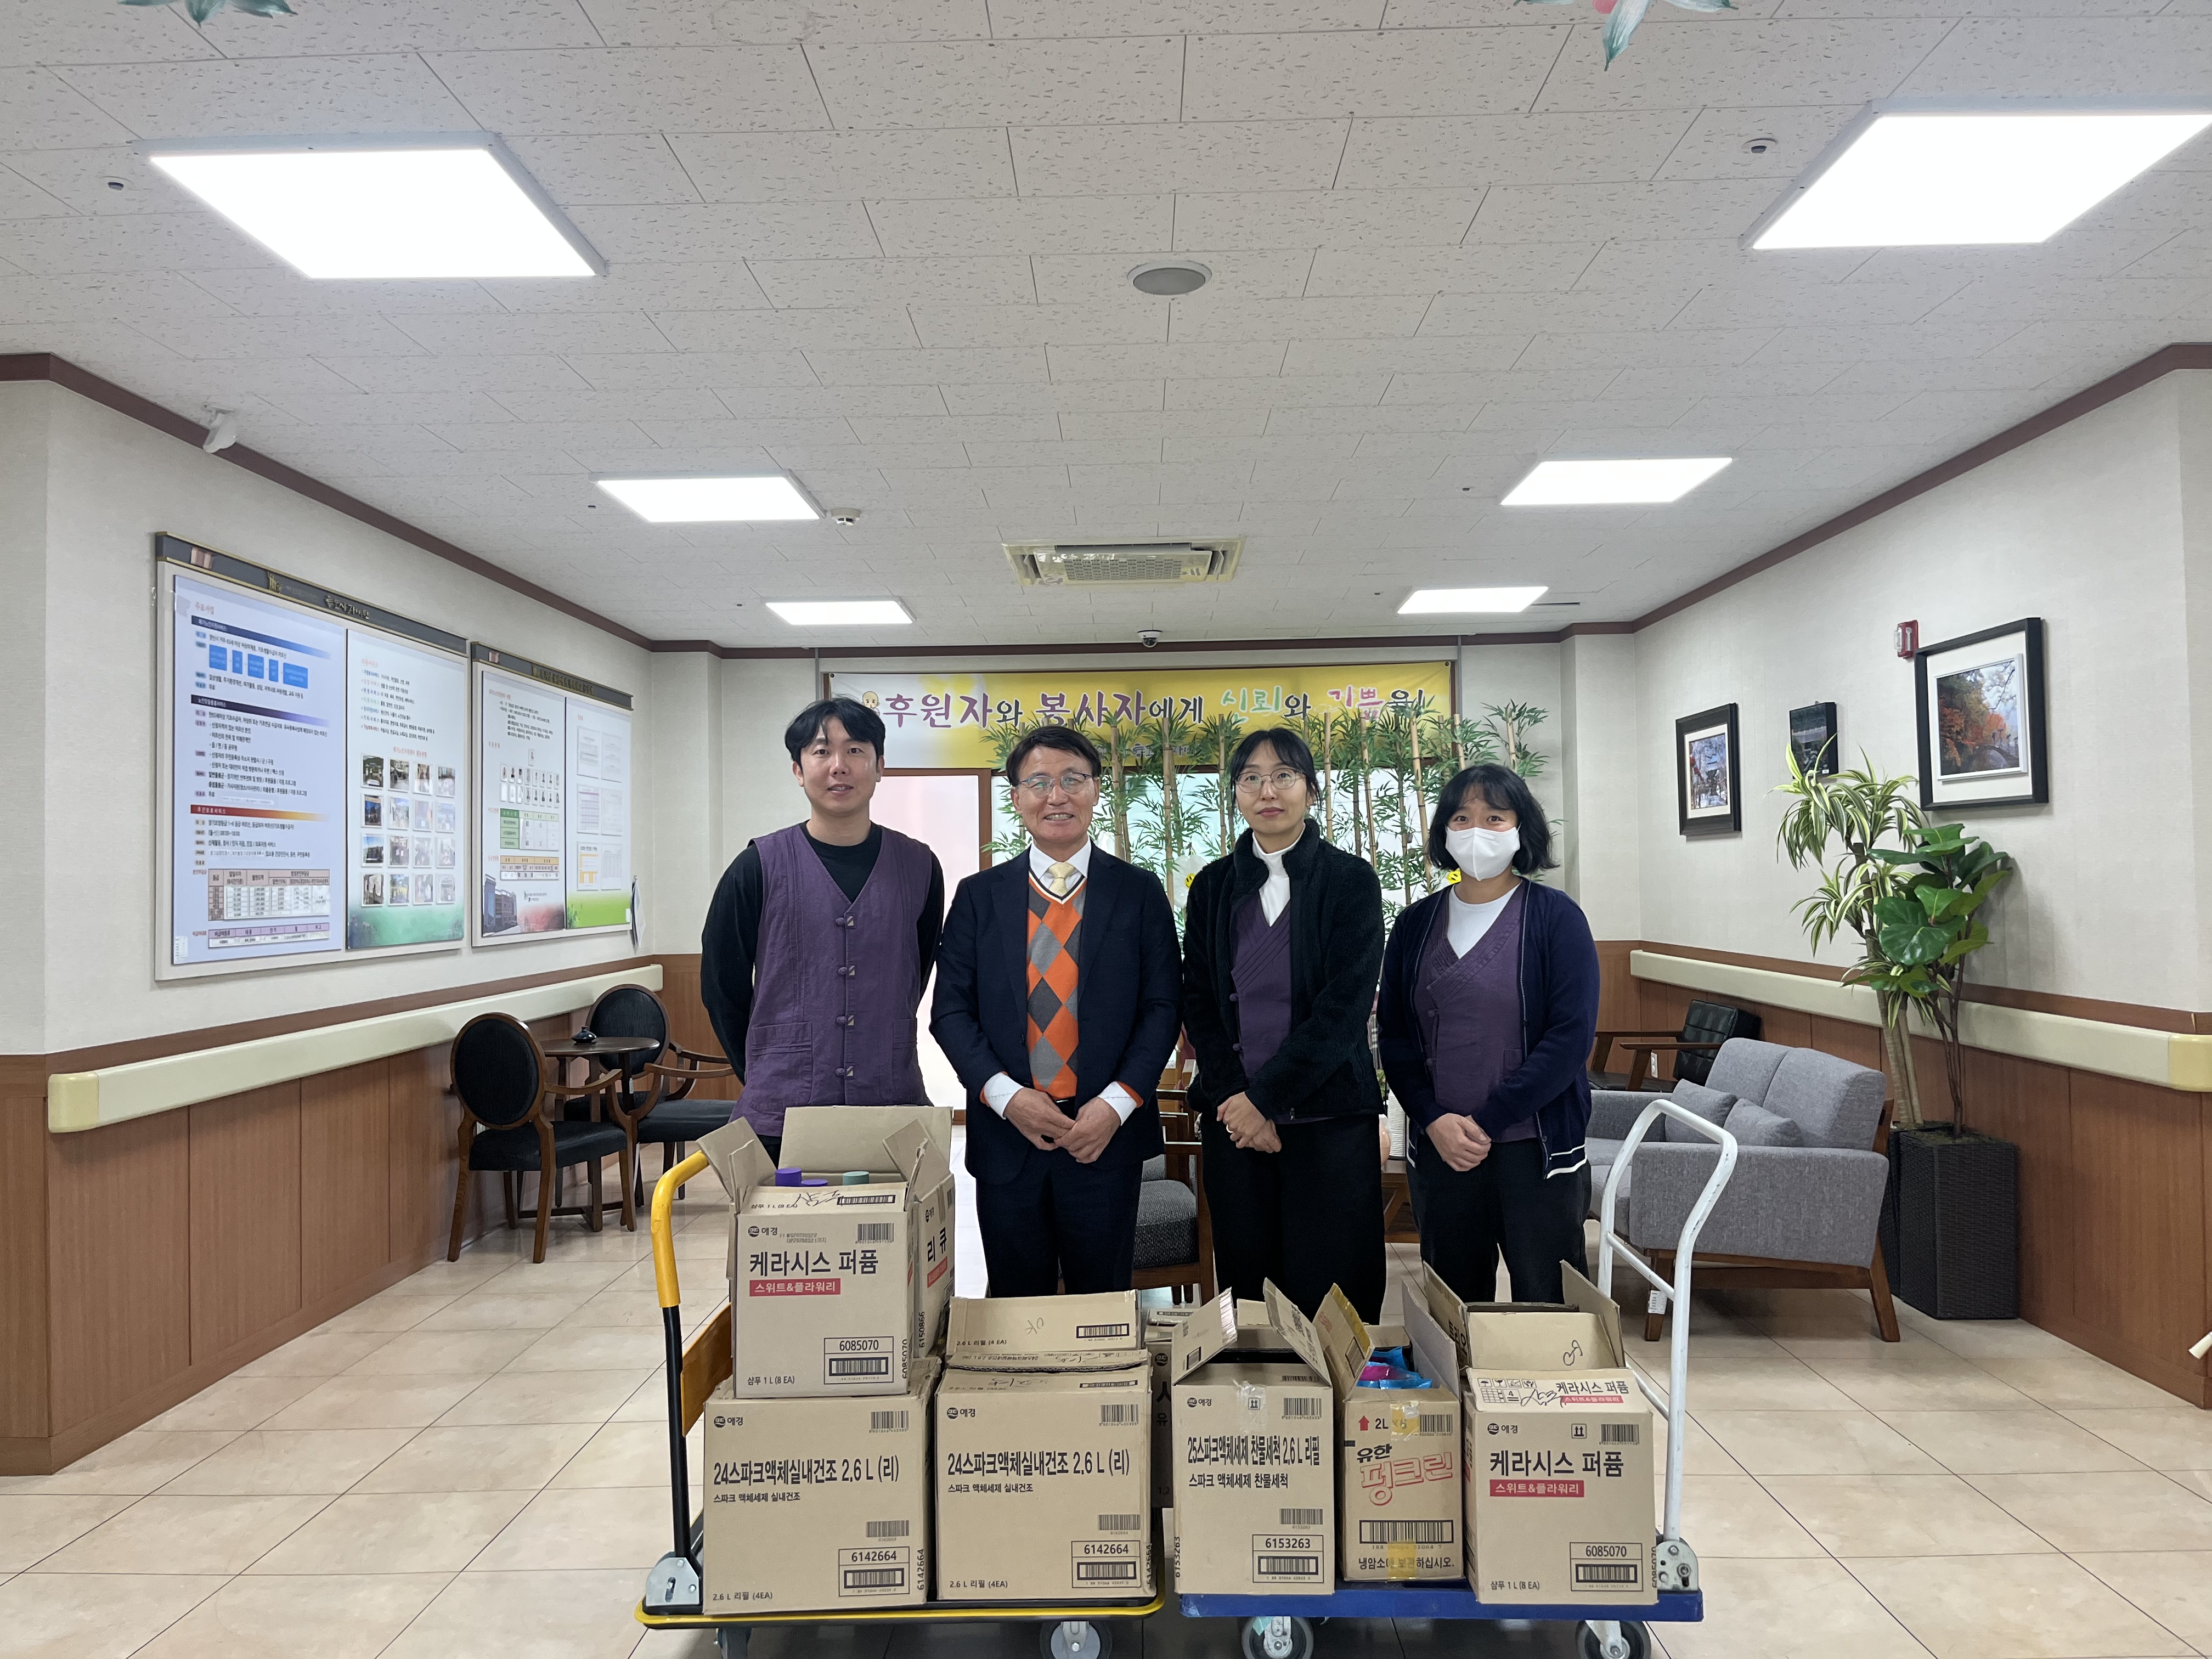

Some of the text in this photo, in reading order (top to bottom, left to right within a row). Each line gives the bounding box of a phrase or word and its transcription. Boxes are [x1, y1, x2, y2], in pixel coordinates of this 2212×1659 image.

[883, 692, 1023, 727] 후원자와
[1036, 690, 1204, 725] 봉사자에게
[1221, 686, 1311, 723] 신뢰와
[761, 1227, 778, 1235] 애경
[749, 1249, 879, 1277] 케라시스 퍼퓸
[754, 1281, 836, 1294] 스위트&플라워리
[839, 1340, 879, 1352] 6085070
[747, 1376, 761, 1385] 샴푸
[775, 1376, 782, 1385] (8
[783, 1375, 795, 1385] EA)
[1555, 1381, 1629, 1395] 케라시스 퍼퓸
[1198, 1397, 1212, 1406] 애경
[959, 1408, 976, 1418] 애경
[727, 1417, 743, 1426] 애경
[1375, 1418, 1389, 1430] 2L
[1501, 1425, 1518, 1434] 애경
[1188, 1434, 1320, 1466] 25스파크액체세제 찬물세척 2.6 L 리필
[1356, 1443, 1392, 1463] 유한
[947, 1448, 1130, 1477] 24스파크액체실내건조 2.6 L (리)
[1490, 1450, 1624, 1477] 케라시스 퍼퓸
[713, 1455, 899, 1486] 24스파크액체실내건조 2.6 L (리)
[1189, 1473, 1289, 1488] 스파크 액체세제 찬물세척
[1359, 1452, 1453, 1505] 펑크린
[948, 1483, 1034, 1493] 스파크 액체세제 실내건조
[1495, 1483, 1579, 1494] 스위트&플라워리
[713, 1491, 801, 1503] 스파크 액체세제 실내건조
[1084, 1544, 1130, 1555] 6142664
[1265, 1538, 1311, 1549] 6153263
[851, 1550, 897, 1562] 6142664
[1585, 1545, 1627, 1557] 6085070
[950, 1580, 961, 1588] 2.6
[970, 1579, 985, 1588] 리필
[988, 1579, 1008, 1589] (4EA)
[1490, 1581, 1505, 1590] 샴푸
[1519, 1581, 1526, 1590] (8
[1527, 1581, 1541, 1590] EA)
[713, 1593, 724, 1601] 2.6
[734, 1592, 749, 1601] 리필
[752, 1591, 773, 1600] (4EA)
